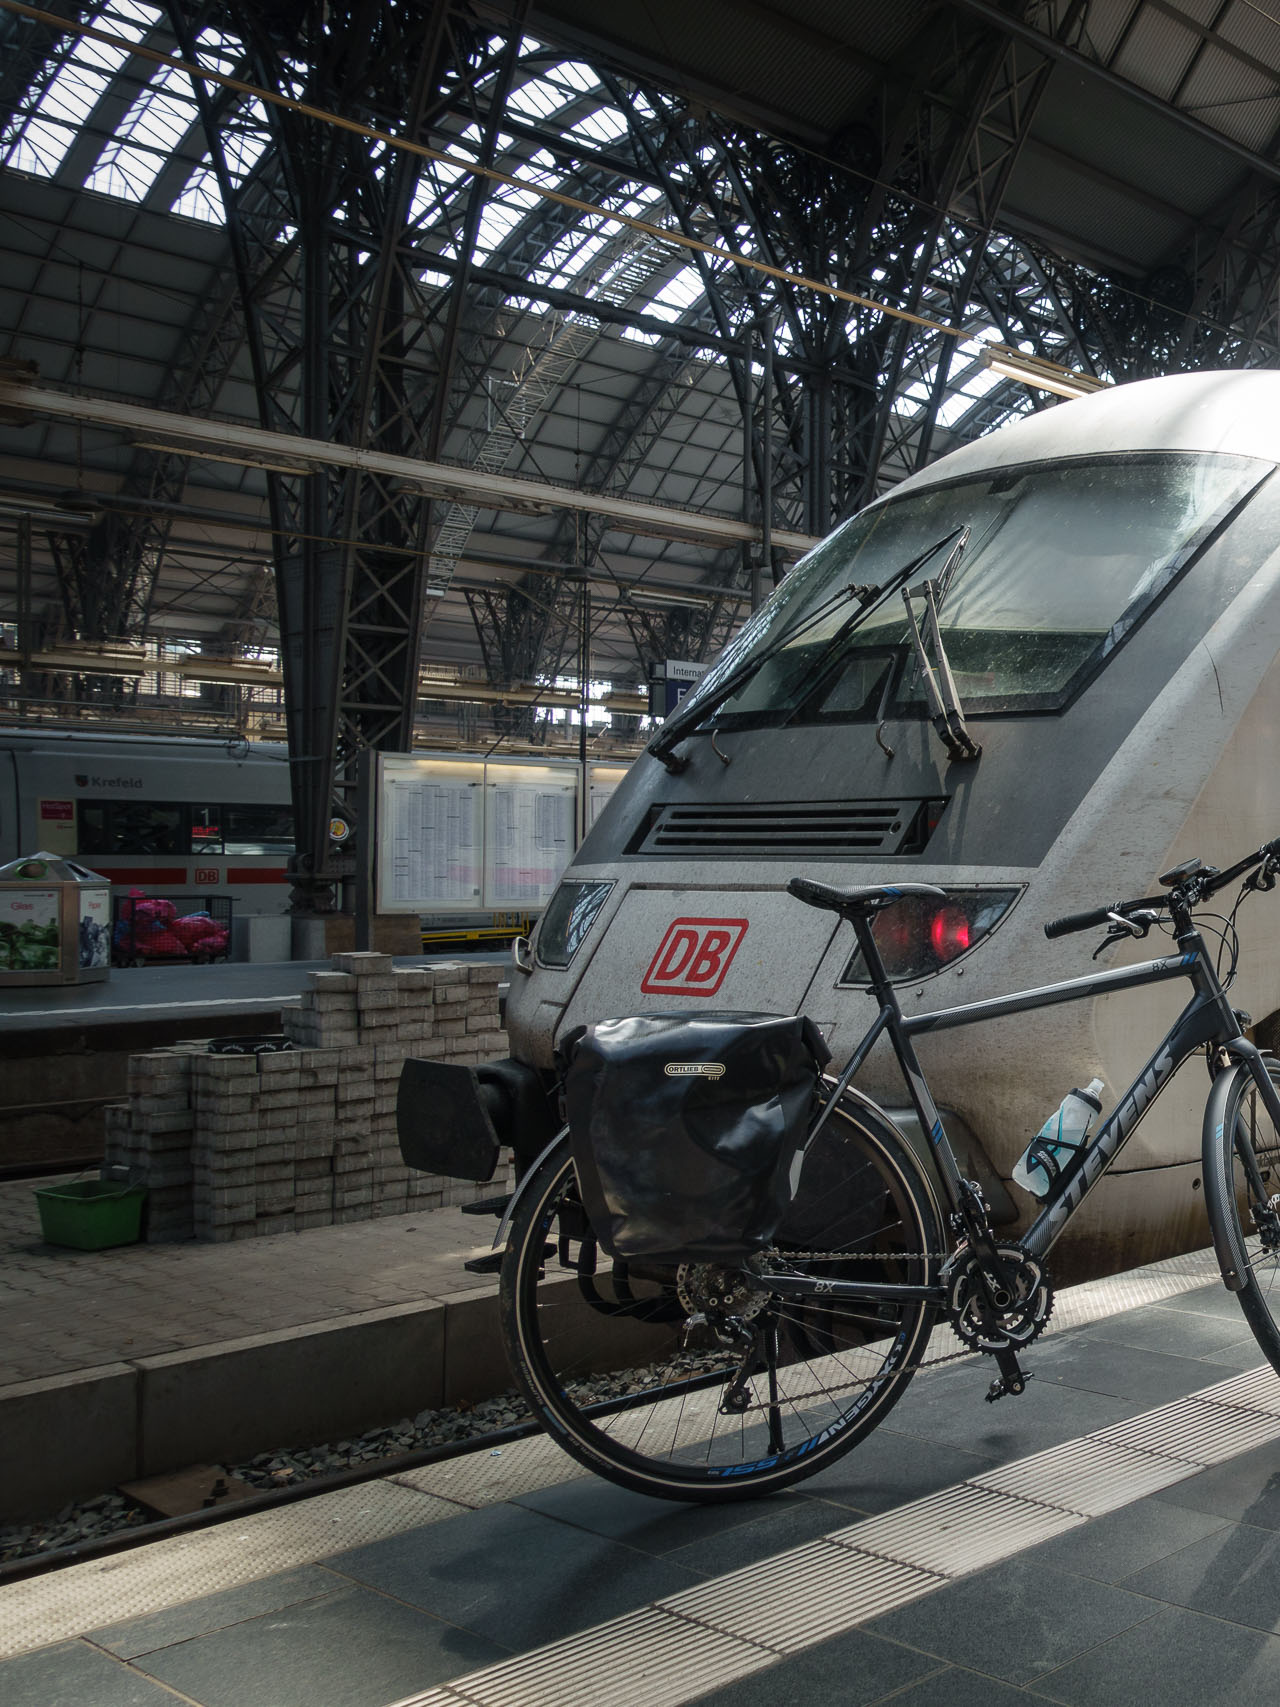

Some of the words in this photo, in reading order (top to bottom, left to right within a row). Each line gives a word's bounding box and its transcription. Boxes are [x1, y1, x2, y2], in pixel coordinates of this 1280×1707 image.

[91, 776, 143, 789] Krefeld
[200, 808, 209, 826] 1
[197, 870, 217, 882] DB
[10, 901, 34, 911] Glas
[652, 928, 733, 983] DB
[1152, 960, 1169, 973] 8X
[1050, 1044, 1173, 1222] STEVENS
[814, 1280, 836, 1292] 8X
[830, 1343, 903, 1436] OXYGEN
